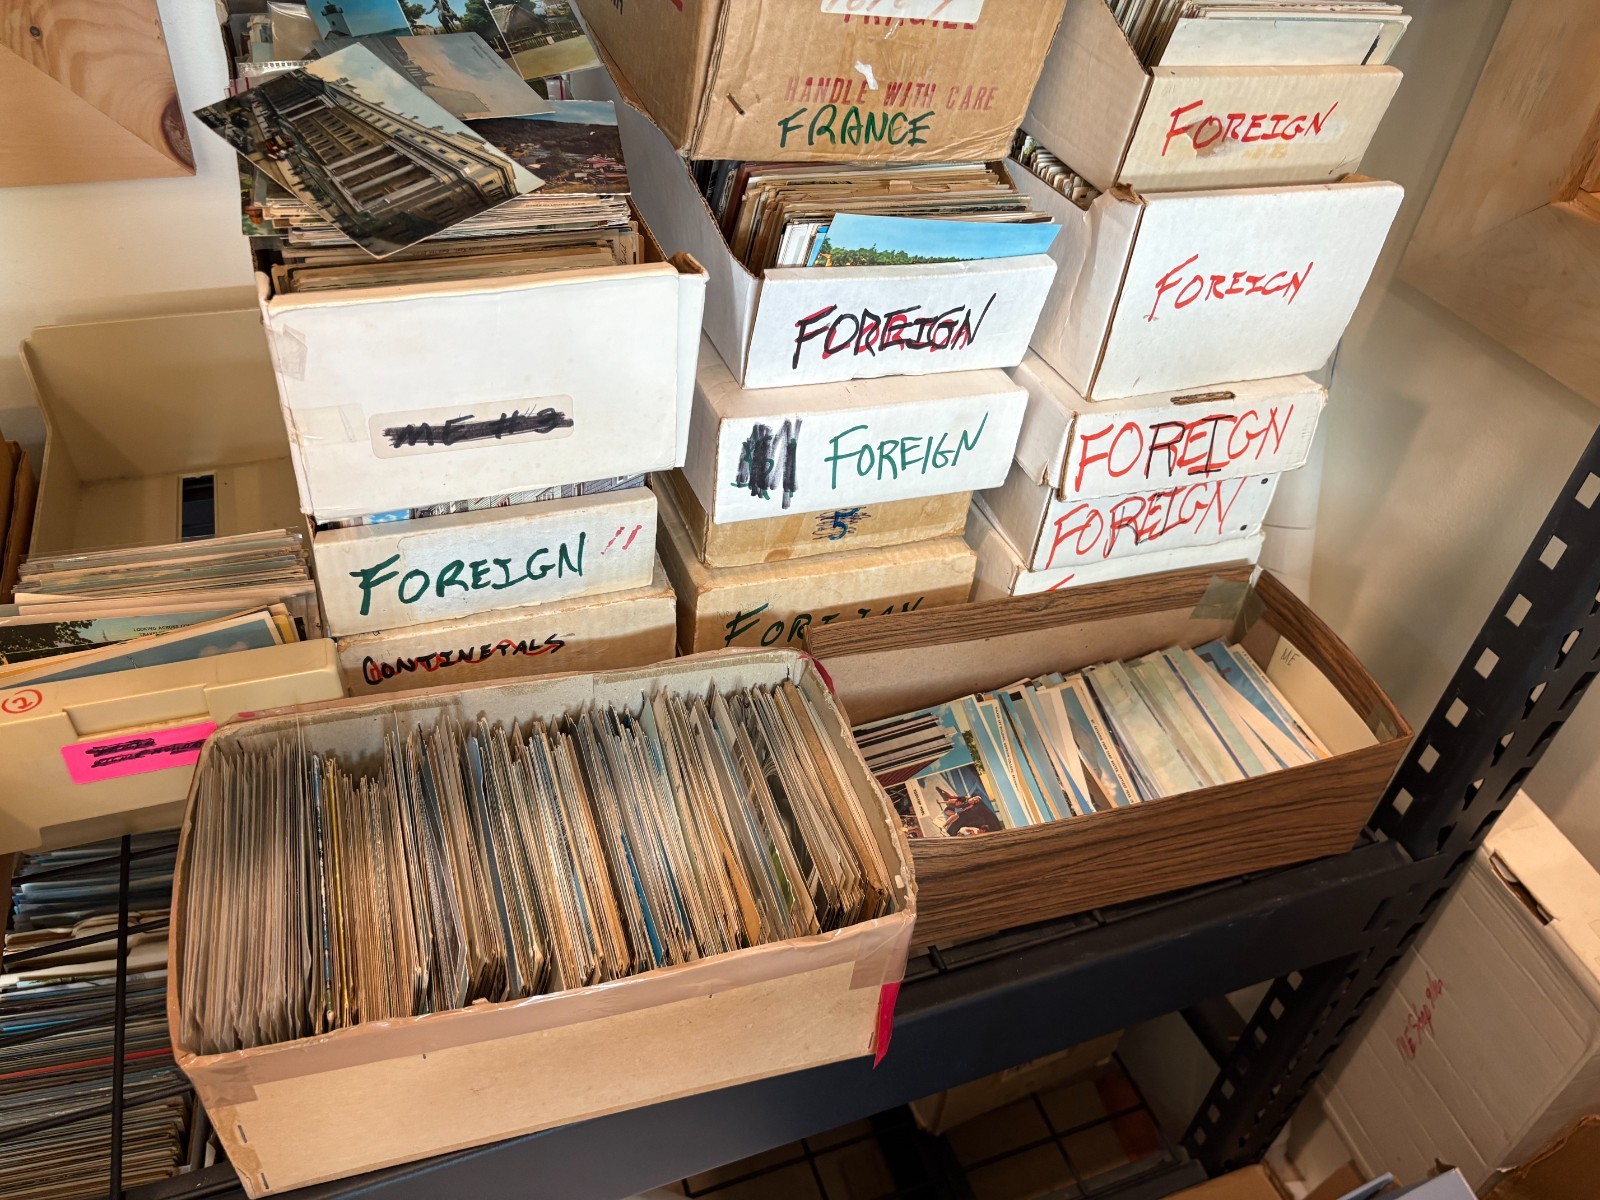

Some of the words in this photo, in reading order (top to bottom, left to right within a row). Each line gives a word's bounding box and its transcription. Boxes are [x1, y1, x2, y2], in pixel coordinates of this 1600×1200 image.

[777, 103, 936, 148] FRANCE
[784, 76, 869, 106] HANDLE
[883, 81, 937, 108] WITH
[945, 85, 1000, 111] CARE
[1161, 99, 1339, 157] FOREIGN
[1147, 253, 1314, 323] FOREIGN
[792, 292, 997, 370] FOREIGN
[824, 411, 989, 490] FOREIGN
[1074, 403, 1294, 492] FOREIGN
[1044, 476, 1248, 570] FOREIGN
[350, 531, 587, 616] FOREIGN
